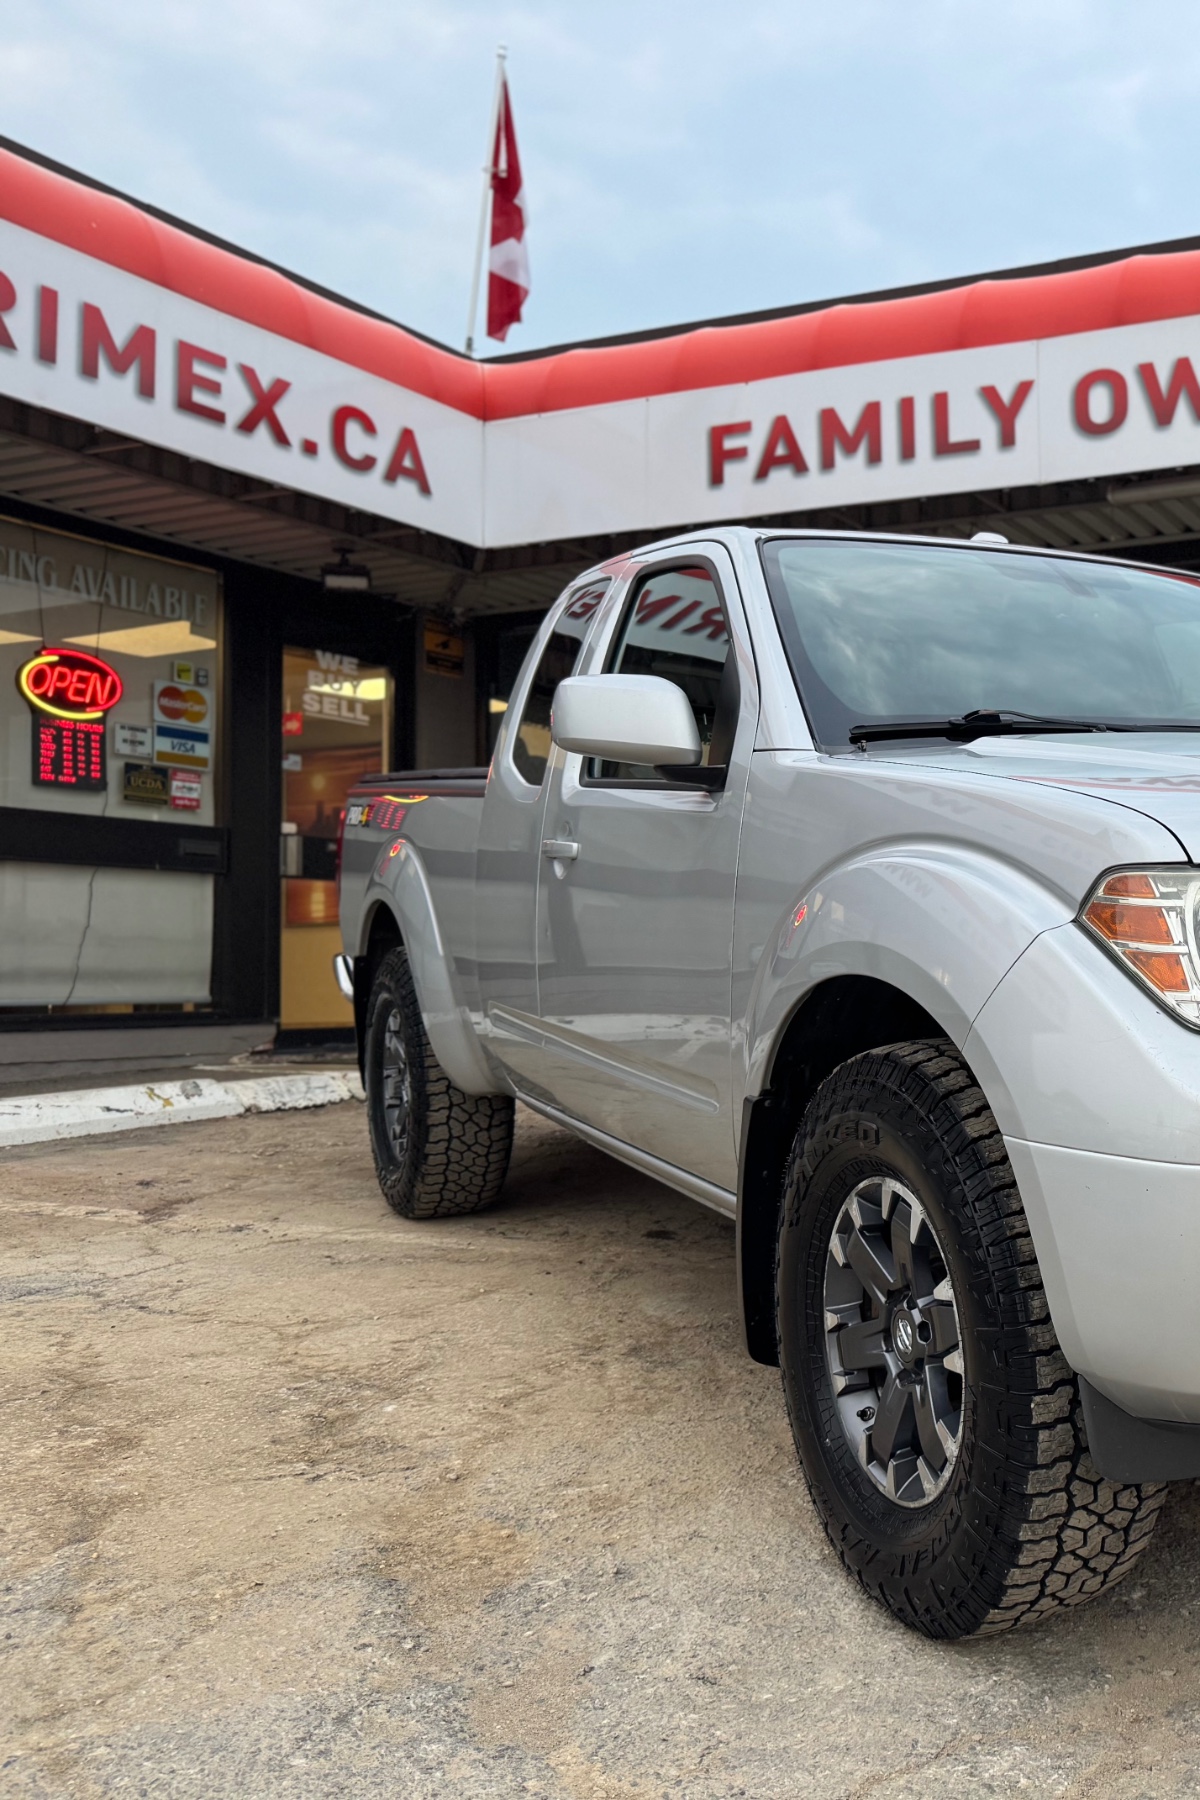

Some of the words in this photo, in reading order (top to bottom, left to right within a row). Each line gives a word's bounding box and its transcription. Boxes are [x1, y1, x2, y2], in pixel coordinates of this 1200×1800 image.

[708, 378, 1036, 487] FAMILY
[0, 545, 58, 593] ING
[70, 564, 208, 628] AVAILABLE
[314, 649, 360, 676] WE
[27, 663, 113, 705] OPEN
[307, 669, 363, 696] BUY
[302, 693, 371, 722] SELL
[170, 740, 196, 755] VISA
[129, 775, 164, 791] UCDA
[345, 804, 376, 828] PRO-4
